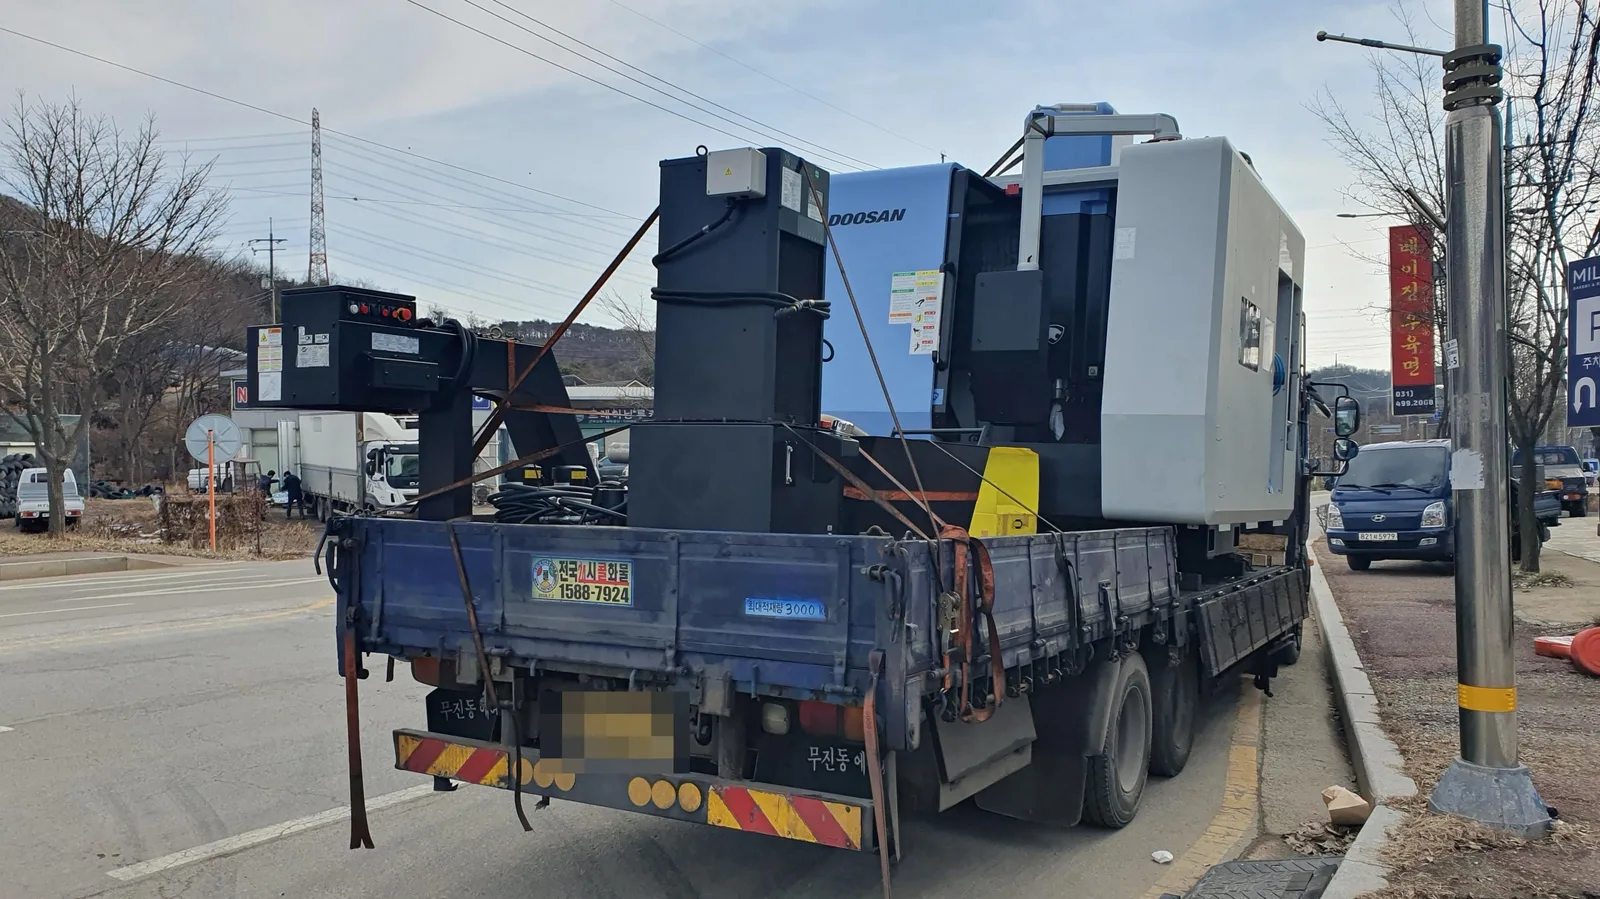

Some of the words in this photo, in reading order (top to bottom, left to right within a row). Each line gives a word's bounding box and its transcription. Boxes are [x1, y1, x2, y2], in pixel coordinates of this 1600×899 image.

[829, 209, 906, 226] DOOSAN
[559, 583, 629, 603] 1588-7924
[748, 601, 783, 614] 최대적재량
[785, 602, 815, 616] 3000
[440, 699, 477, 721] 무진동
[807, 746, 850, 772] 무진동
